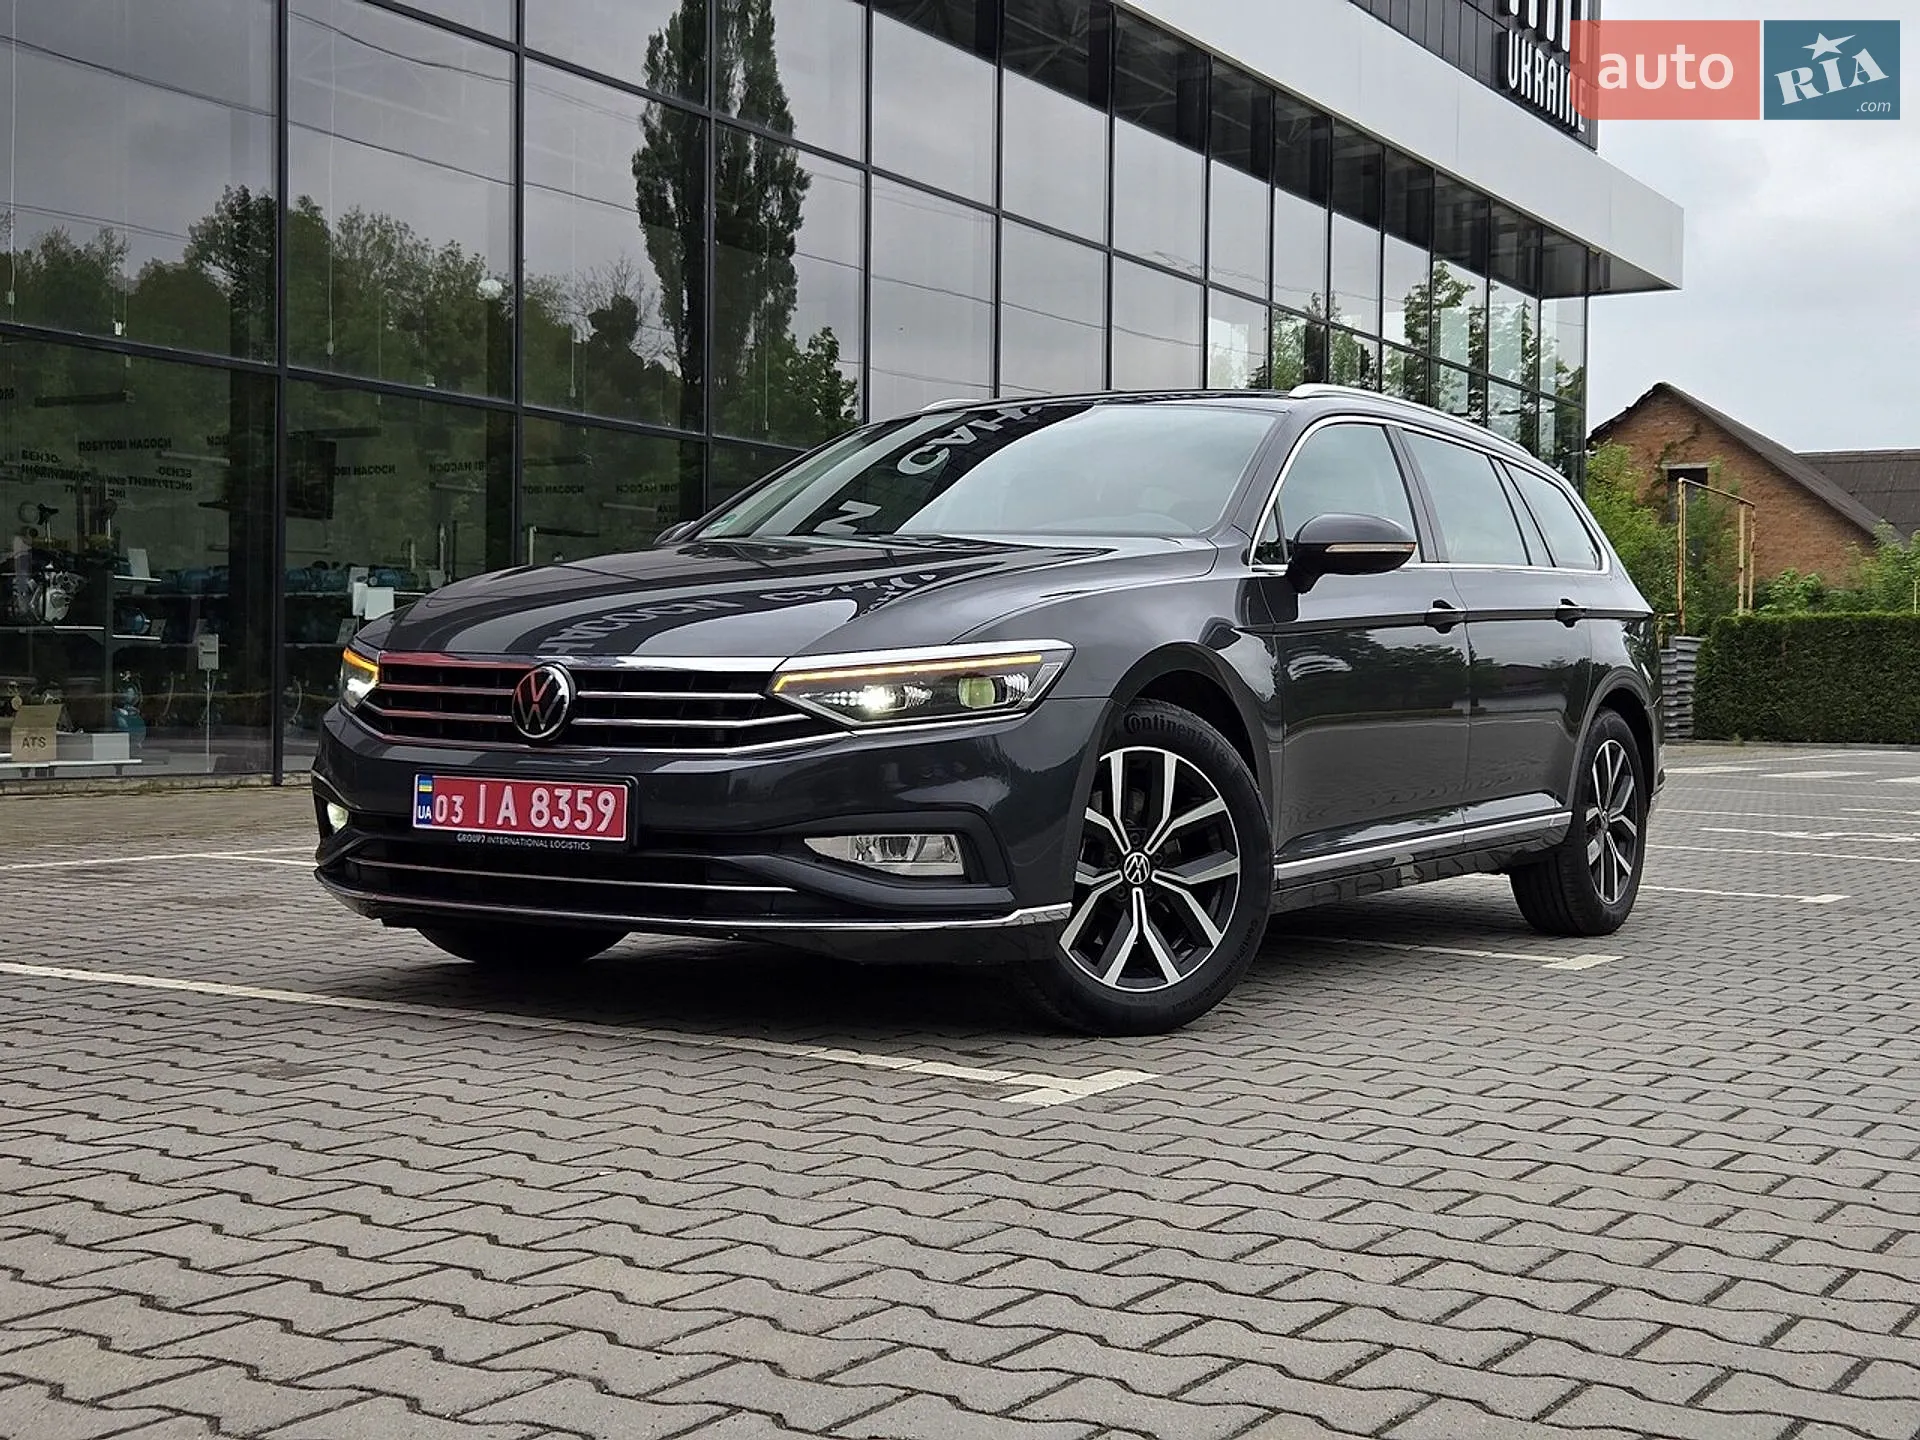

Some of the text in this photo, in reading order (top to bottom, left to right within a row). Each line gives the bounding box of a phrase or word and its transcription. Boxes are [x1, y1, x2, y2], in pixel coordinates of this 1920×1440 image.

[22, 736, 46, 749] ATS
[418, 805, 432, 820] UA
[435, 794, 465, 824] 03
[529, 787, 617, 832] 8359
[487, 835, 548, 848] INTERNATIONAL
[550, 839, 591, 850] LOGISTICS
